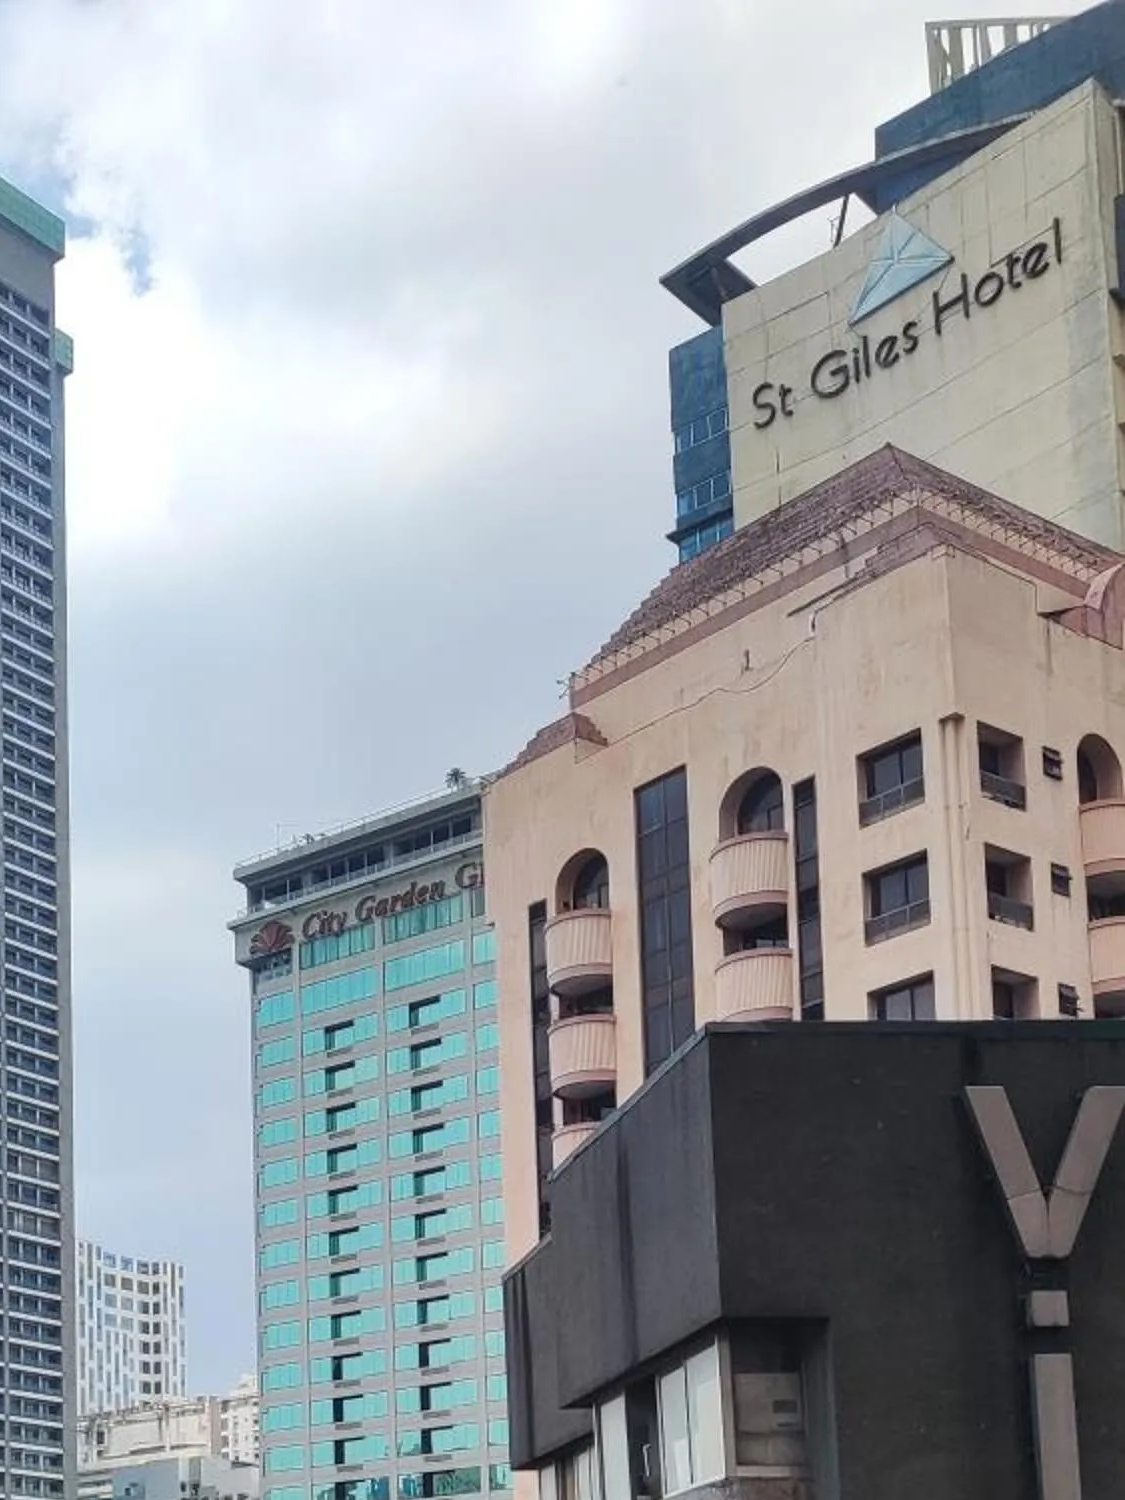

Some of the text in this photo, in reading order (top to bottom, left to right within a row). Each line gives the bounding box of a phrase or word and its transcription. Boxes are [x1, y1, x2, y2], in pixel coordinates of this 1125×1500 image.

[752, 217, 1063, 430] St Giles Hotel
[302, 861, 484, 939] City Garden G
